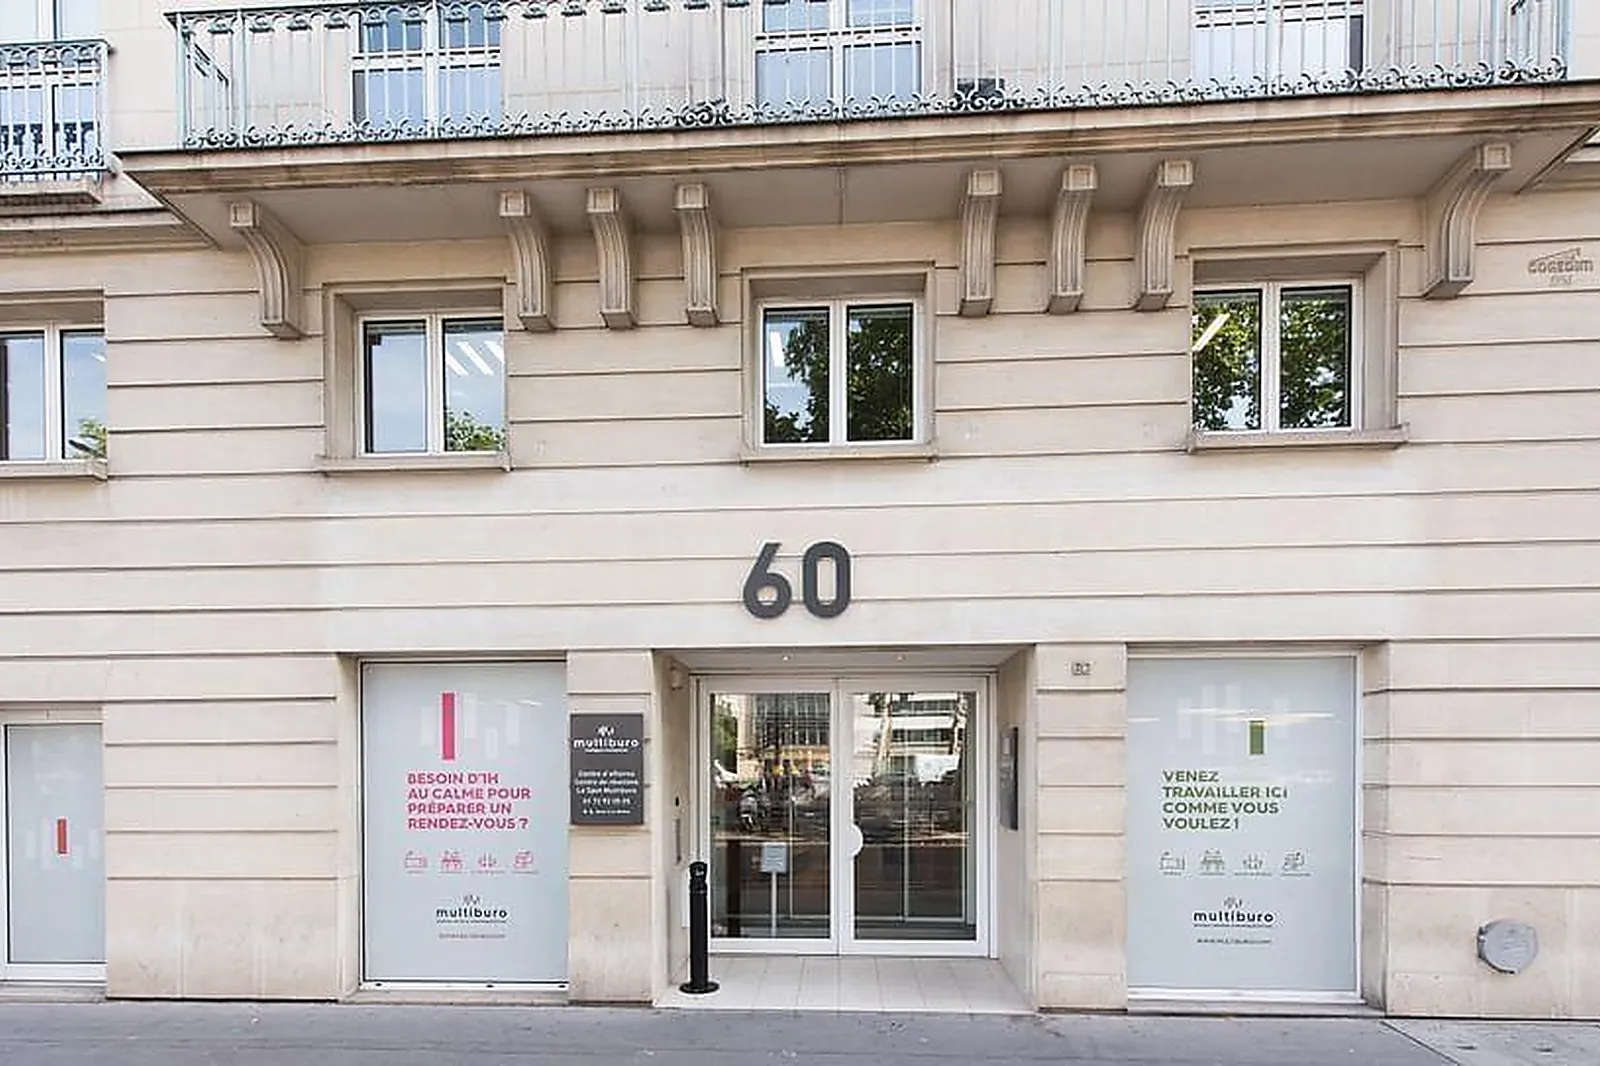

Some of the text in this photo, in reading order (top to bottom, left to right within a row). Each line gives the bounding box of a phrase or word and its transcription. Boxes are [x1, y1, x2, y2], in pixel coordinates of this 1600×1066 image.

[743, 541, 851, 618] 60
[407, 773, 463, 784] BESOIN
[1163, 770, 1219, 782] VENEZ
[407, 788, 531, 799] AU CALME POUR
[1162, 786, 1288, 798] TRAVAILLER ICI
[489, 802, 512, 813] UN
[1162, 802, 1279, 813] COMME VOUS
[407, 818, 529, 829] RENDEZ-VOUS ?
[1163, 818, 1231, 829] VOULEZ
[436, 908, 508, 918] multiburo
[1193, 911, 1274, 922] multiburo
